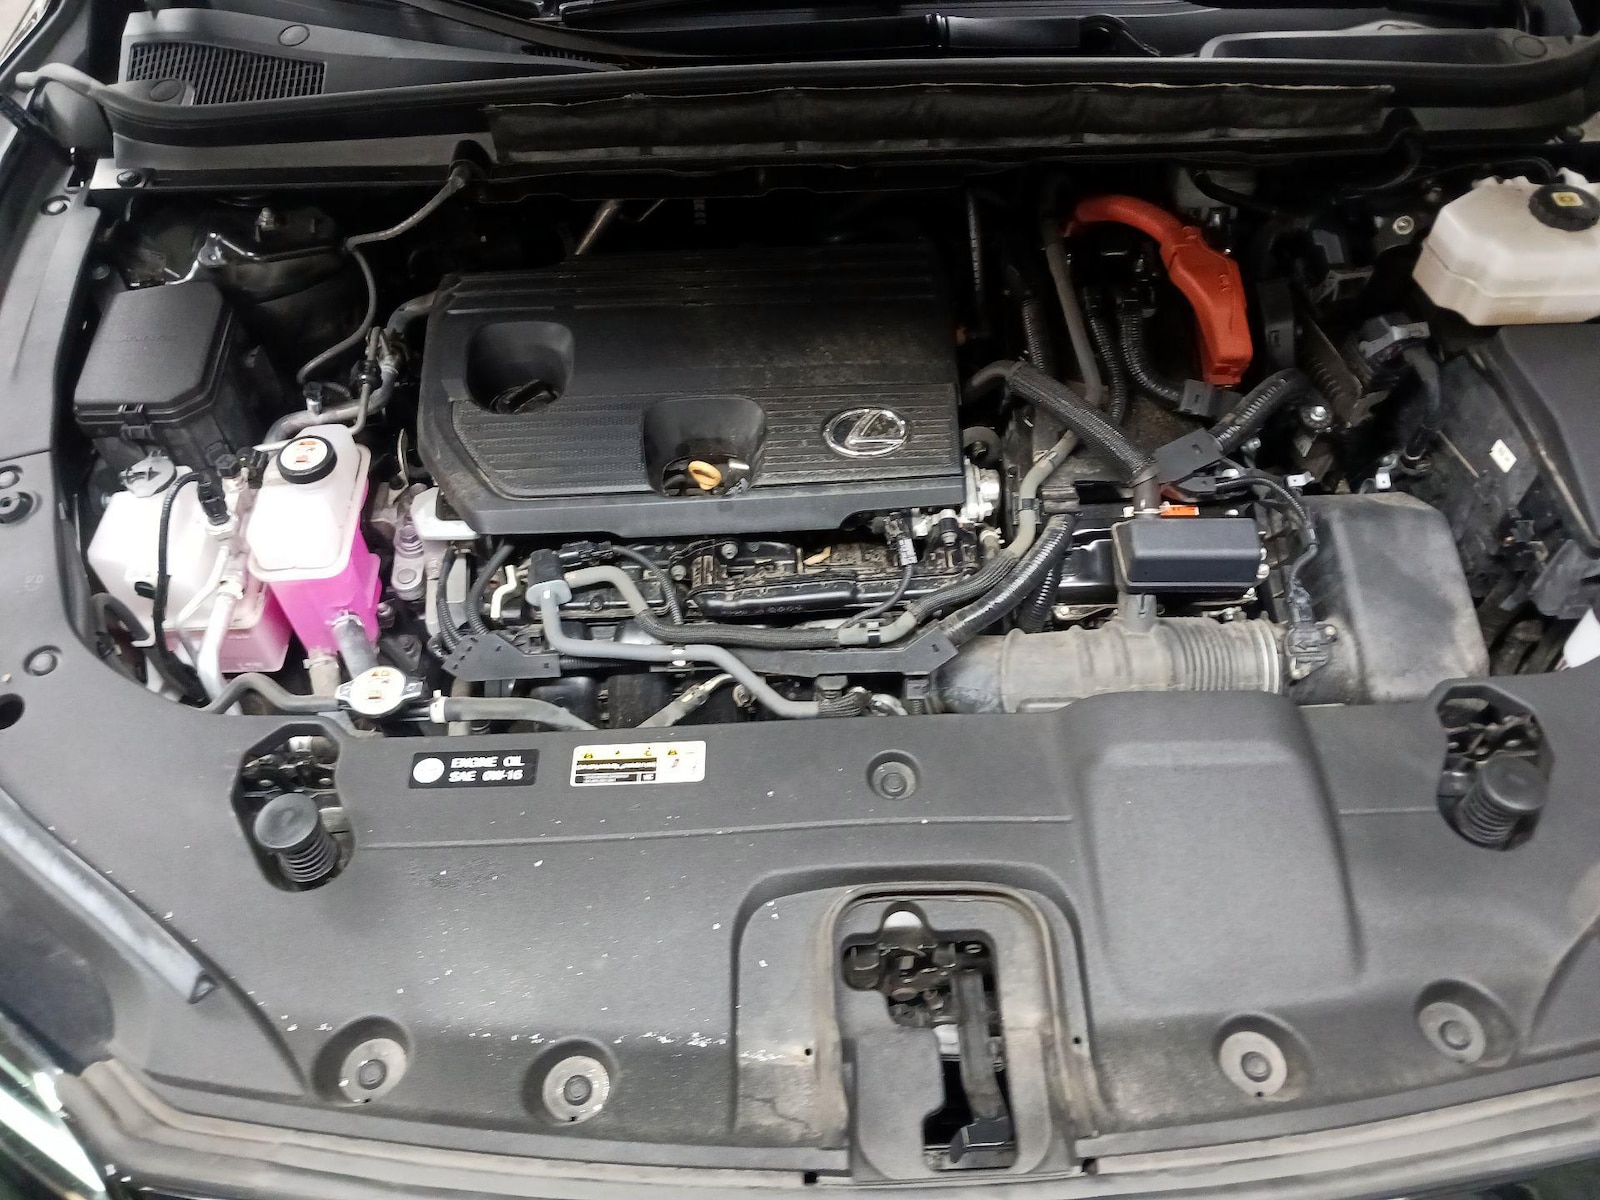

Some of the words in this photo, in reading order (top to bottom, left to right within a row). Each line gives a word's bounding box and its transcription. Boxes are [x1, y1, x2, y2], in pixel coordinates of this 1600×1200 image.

[450, 756, 499, 768] ENGINE
[502, 755, 525, 767] OIL
[448, 770, 477, 782] SAE
